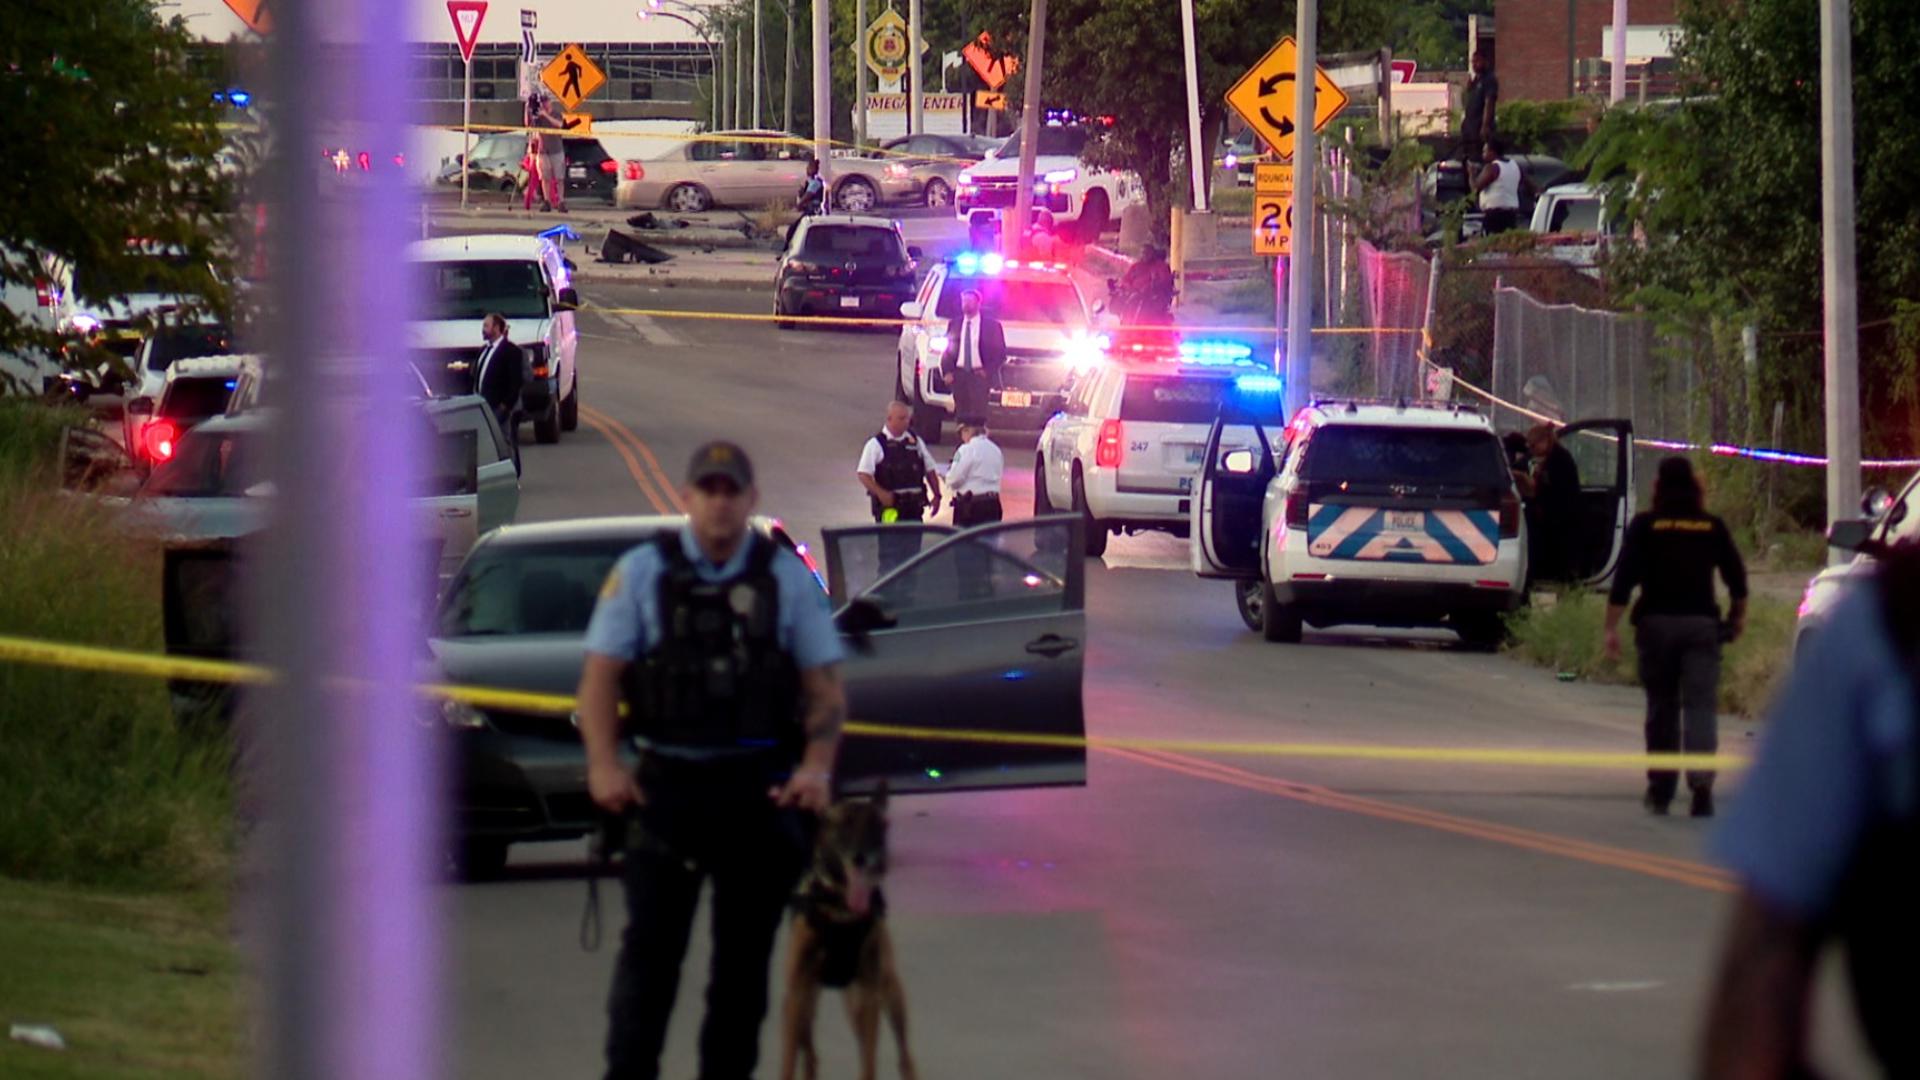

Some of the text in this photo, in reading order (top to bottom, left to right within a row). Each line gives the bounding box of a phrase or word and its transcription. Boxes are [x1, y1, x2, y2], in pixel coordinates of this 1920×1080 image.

[923, 96, 963, 110] ENTER
[1259, 174, 1293, 183] ROUNDA
[1265, 235, 1289, 247] MP
[1130, 441, 1149, 451] 247
